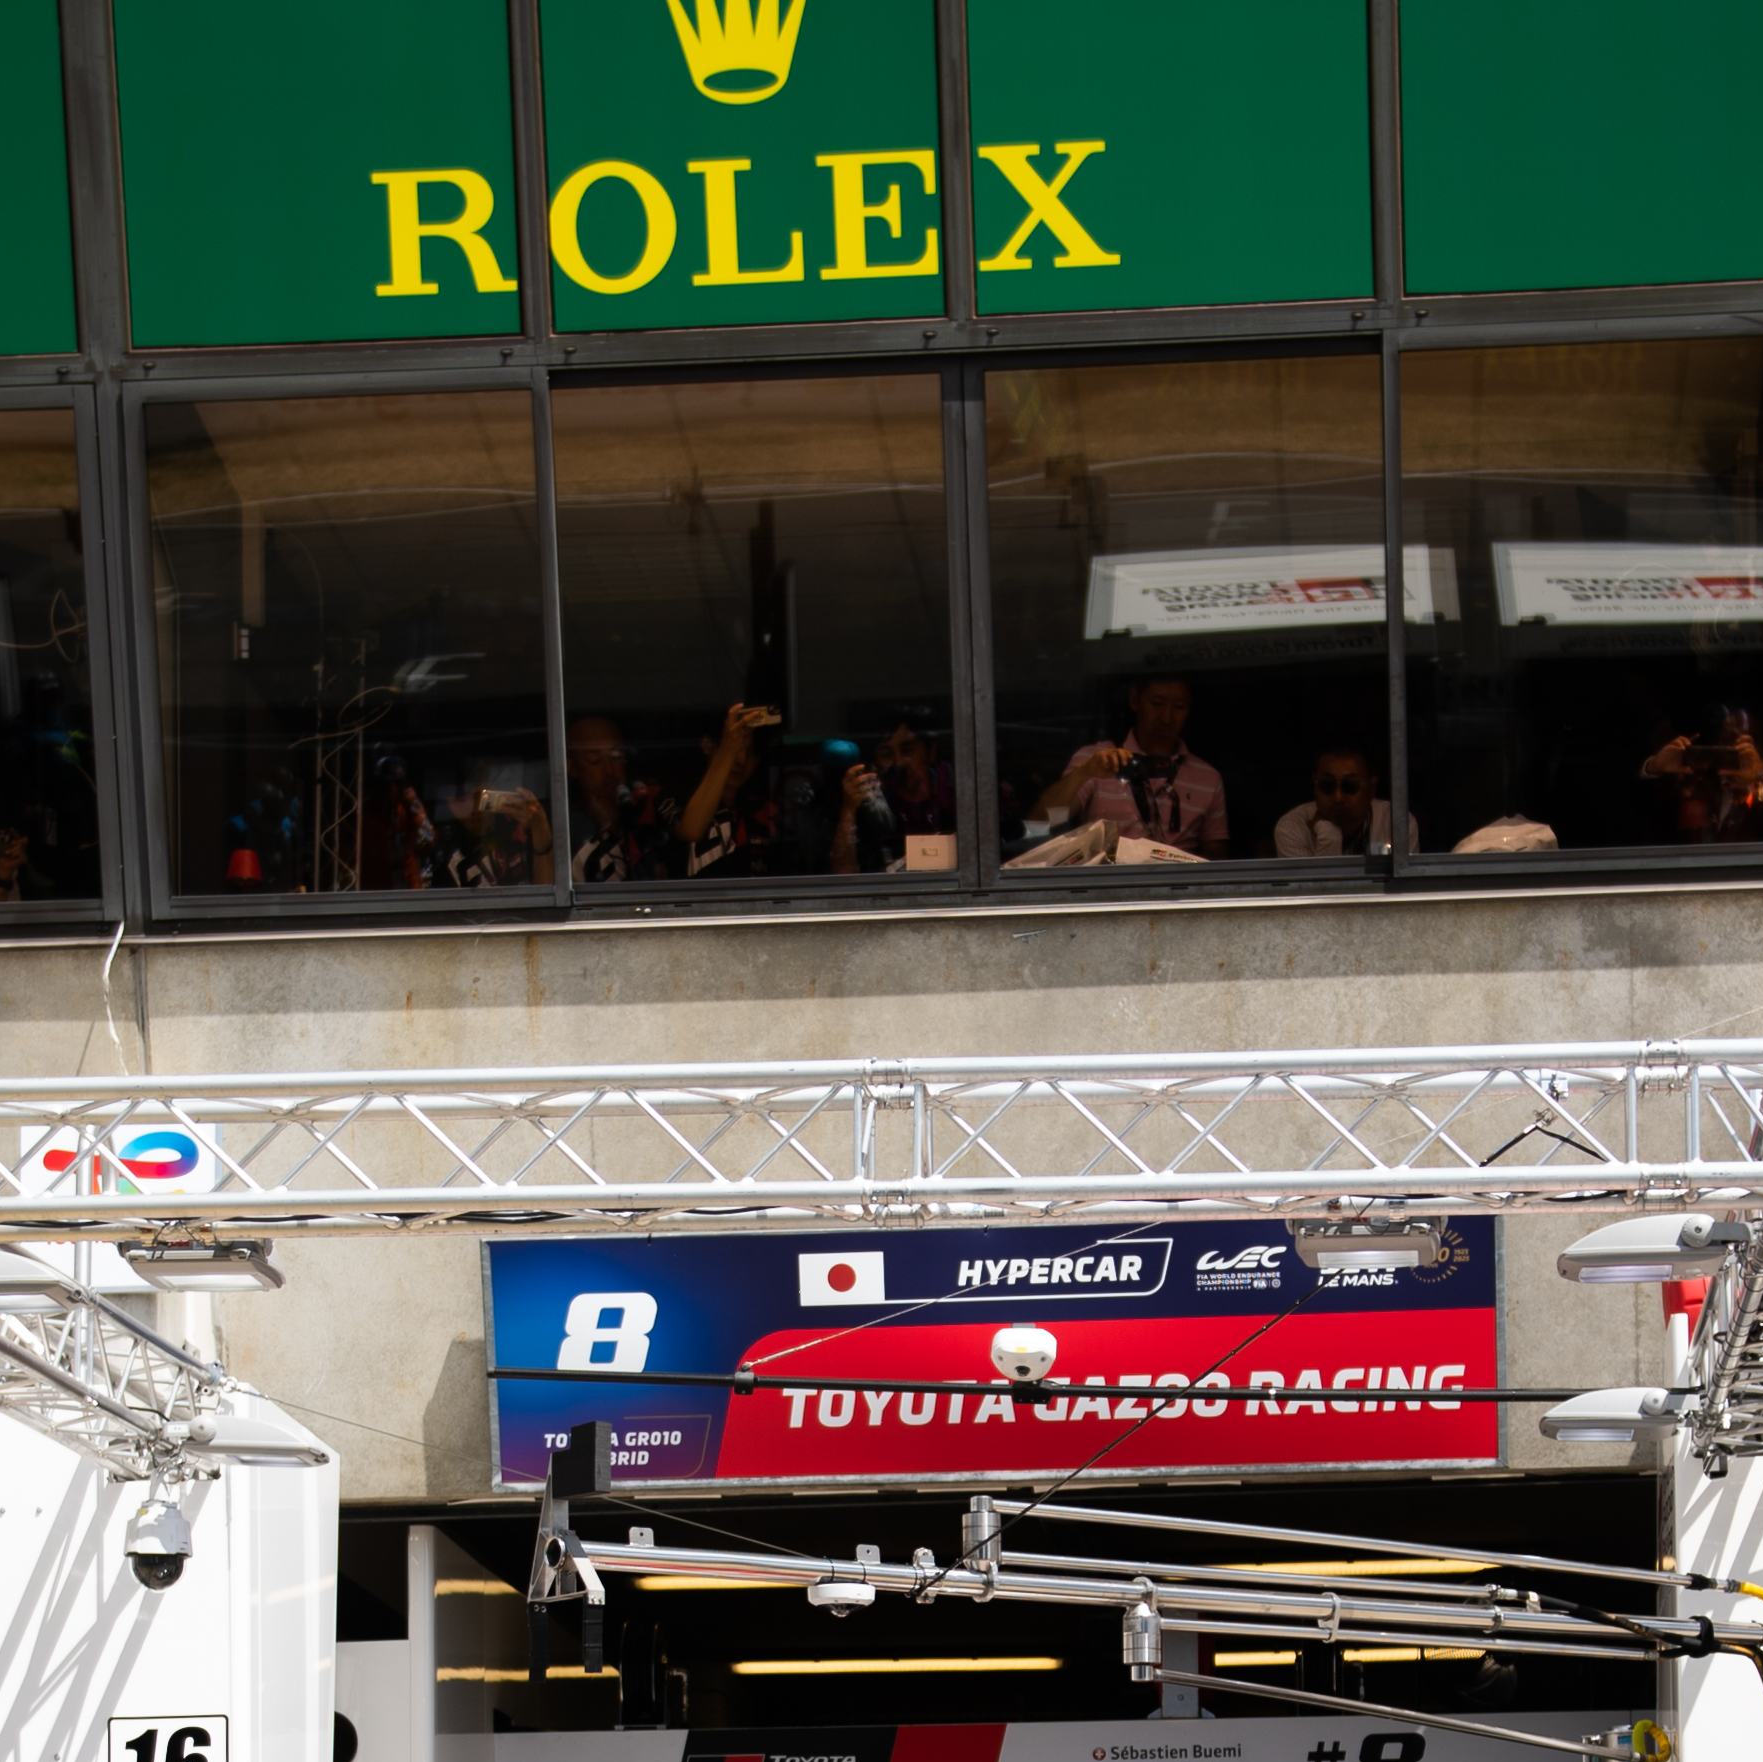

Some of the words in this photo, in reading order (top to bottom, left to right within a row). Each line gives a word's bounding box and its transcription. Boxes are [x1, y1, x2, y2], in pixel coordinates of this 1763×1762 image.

[371, 141, 1121, 297] ROLEX
[958, 1255, 1143, 1288] HYPERCAR
[1196, 1246, 1288, 1270] WEC
[1342, 1274, 1395, 1287] MANS
[557, 1292, 658, 1374] 8
[783, 1380, 1015, 1428] TOYOTA
[1034, 1373, 1231, 1422] GAZOO
[1245, 1364, 1465, 1416] RACING
[625, 1431, 682, 1448] GR010
[1110, 1745, 1189, 1761] Sébastien
[1193, 1743, 1242, 1759] Buemi
